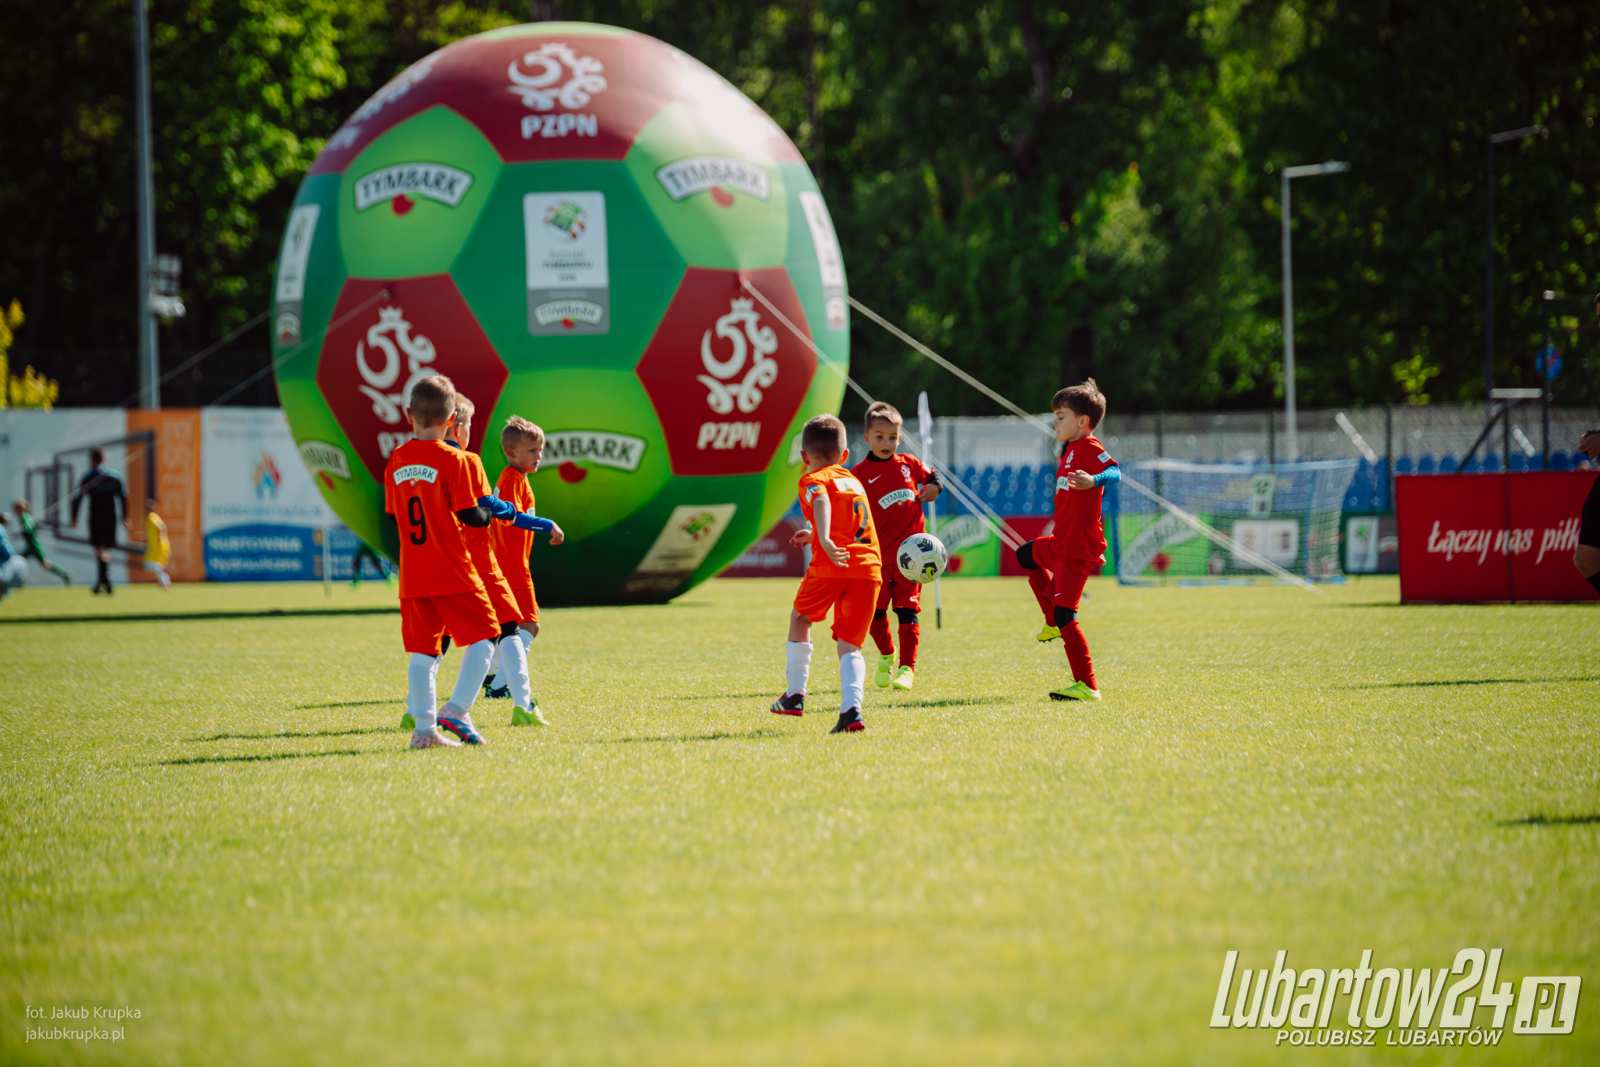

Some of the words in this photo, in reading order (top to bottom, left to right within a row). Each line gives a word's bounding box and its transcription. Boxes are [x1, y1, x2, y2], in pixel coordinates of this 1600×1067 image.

[521, 112, 598, 139] PZPN
[361, 168, 463, 199] TYMBARK
[696, 421, 761, 449] PZPN
[543, 436, 636, 464] MBARK
[395, 467, 435, 481] TYMBARK
[408, 496, 426, 545] 9
[853, 500, 871, 544] 2
[1427, 519, 1493, 566] Łączy
[1493, 528, 1534, 556] nas
[1535, 517, 1581, 565] piłk
